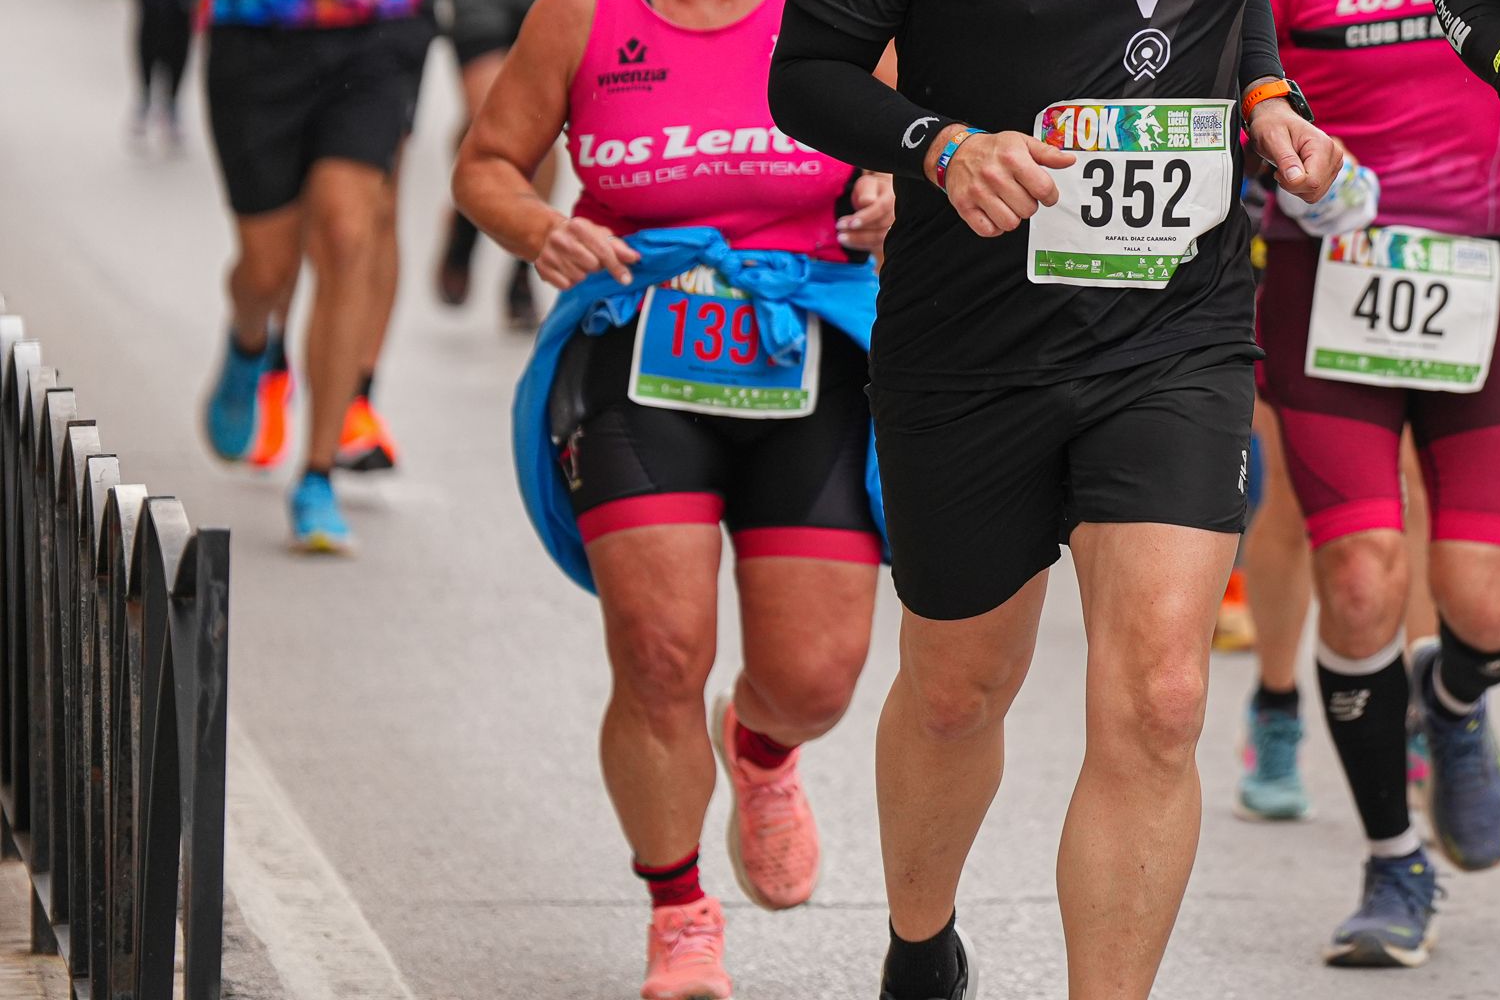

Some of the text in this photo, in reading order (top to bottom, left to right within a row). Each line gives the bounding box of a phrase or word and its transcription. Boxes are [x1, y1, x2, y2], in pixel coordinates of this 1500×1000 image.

[1345, 21, 1399, 48] CLUB
[1400, 17, 1430, 42] DE
[662, 125, 821, 159] Lent
[1057, 107, 1120, 150] 10K
[1168, 133, 1189, 148] 2026
[1193, 120, 1222, 131] populares
[578, 134, 654, 168] Los
[599, 160, 823, 189] CLUB DE ATLETISMO
[1080, 158, 1192, 229] 352
[1353, 275, 1450, 337] 402
[667, 298, 777, 367] 139
